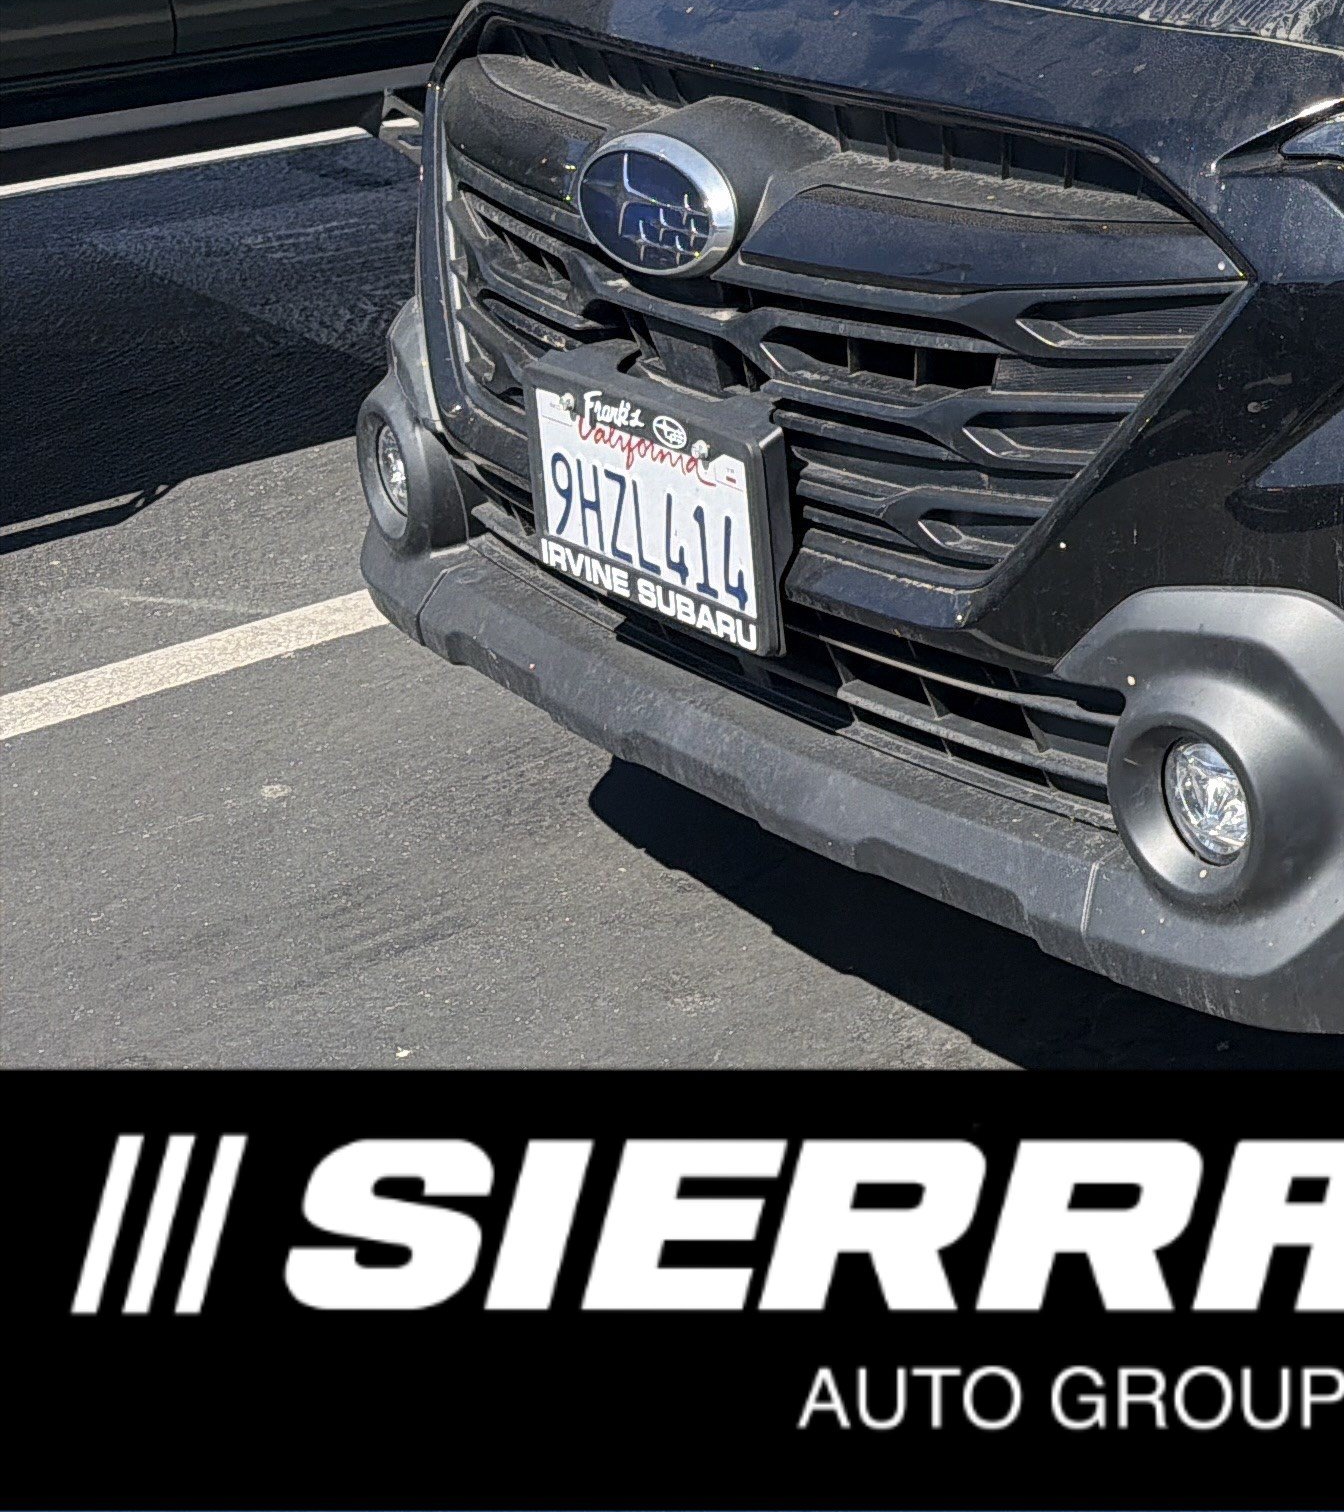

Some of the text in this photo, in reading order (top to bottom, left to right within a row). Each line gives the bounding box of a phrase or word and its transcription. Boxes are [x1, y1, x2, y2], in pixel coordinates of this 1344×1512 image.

[541, 538, 758, 651] IRVINE SUBARU
[550, 451, 749, 612] 9HZL414
